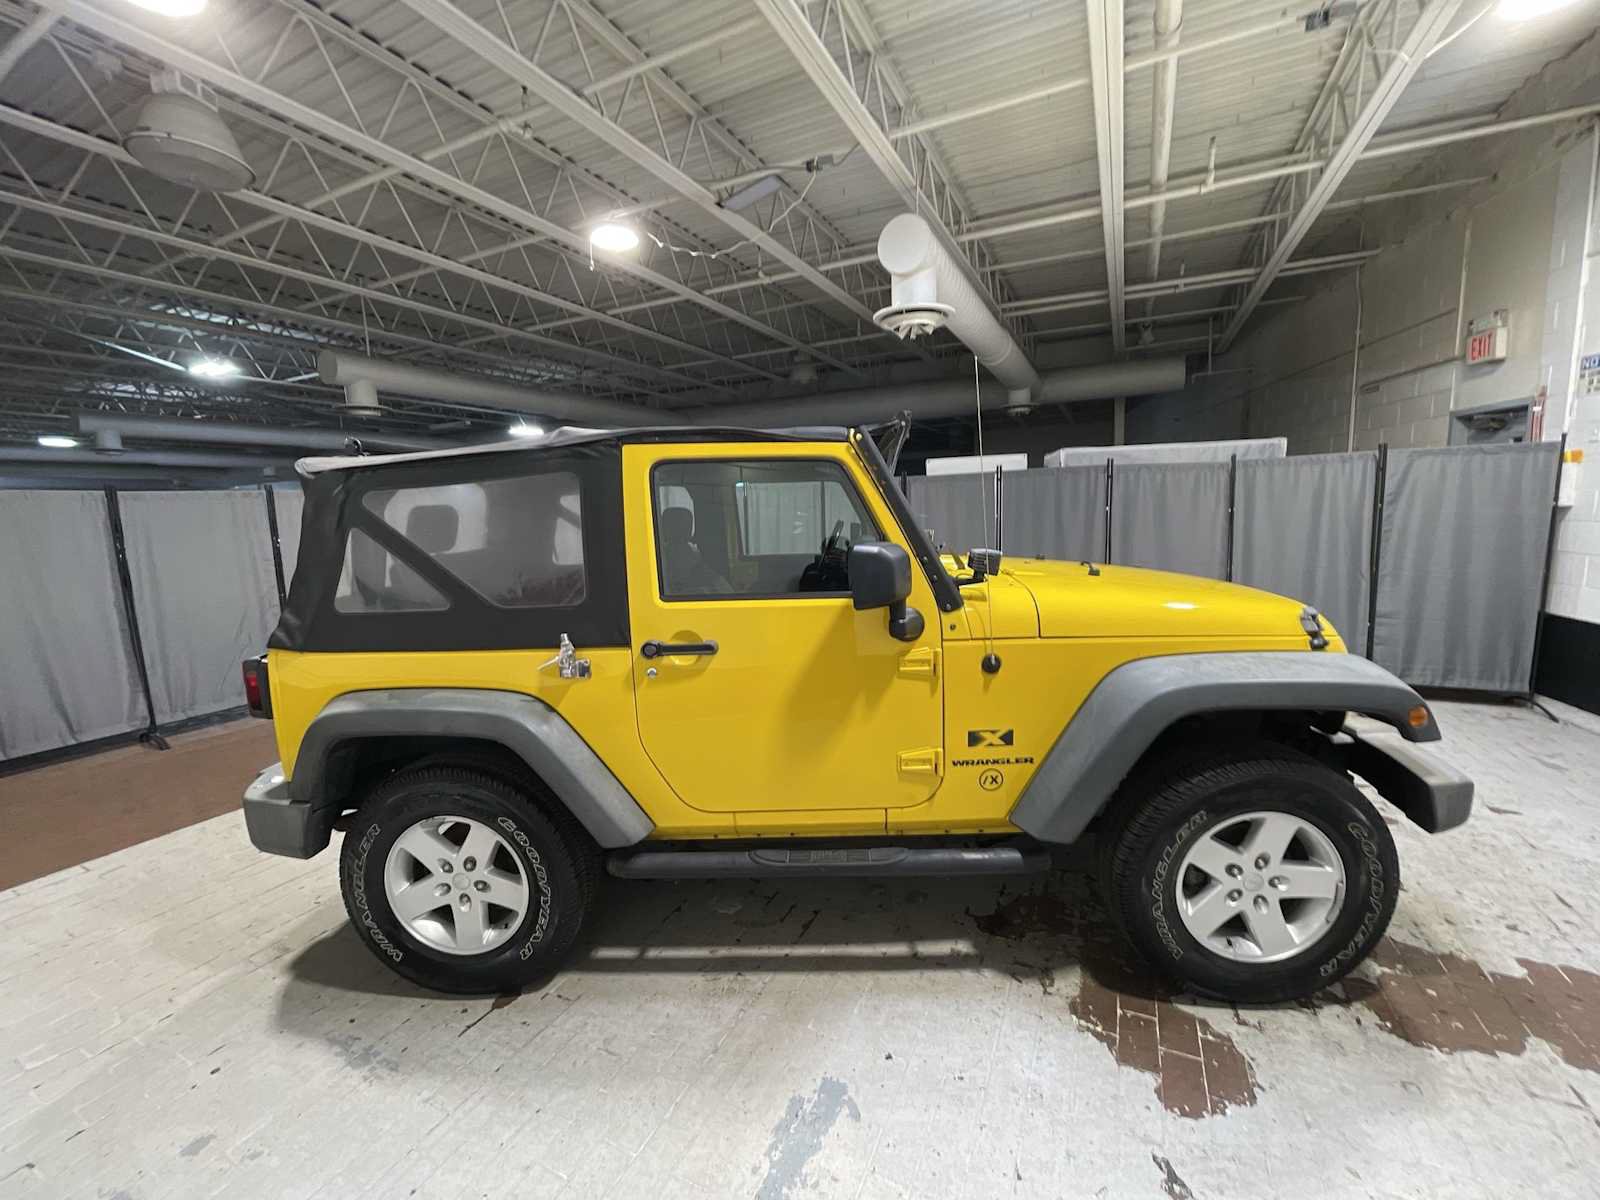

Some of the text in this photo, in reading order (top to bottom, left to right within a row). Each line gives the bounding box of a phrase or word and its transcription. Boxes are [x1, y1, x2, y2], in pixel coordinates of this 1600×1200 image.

[1471, 331, 1494, 361] EXIT
[952, 756, 1035, 767] WRANGLER
[352, 823, 403, 963] WRANGLER
[497, 816, 551, 960] GOODYEAR
[1151, 809, 1208, 961] WRANGLER
[1319, 821, 1385, 977] GOODYEAR
